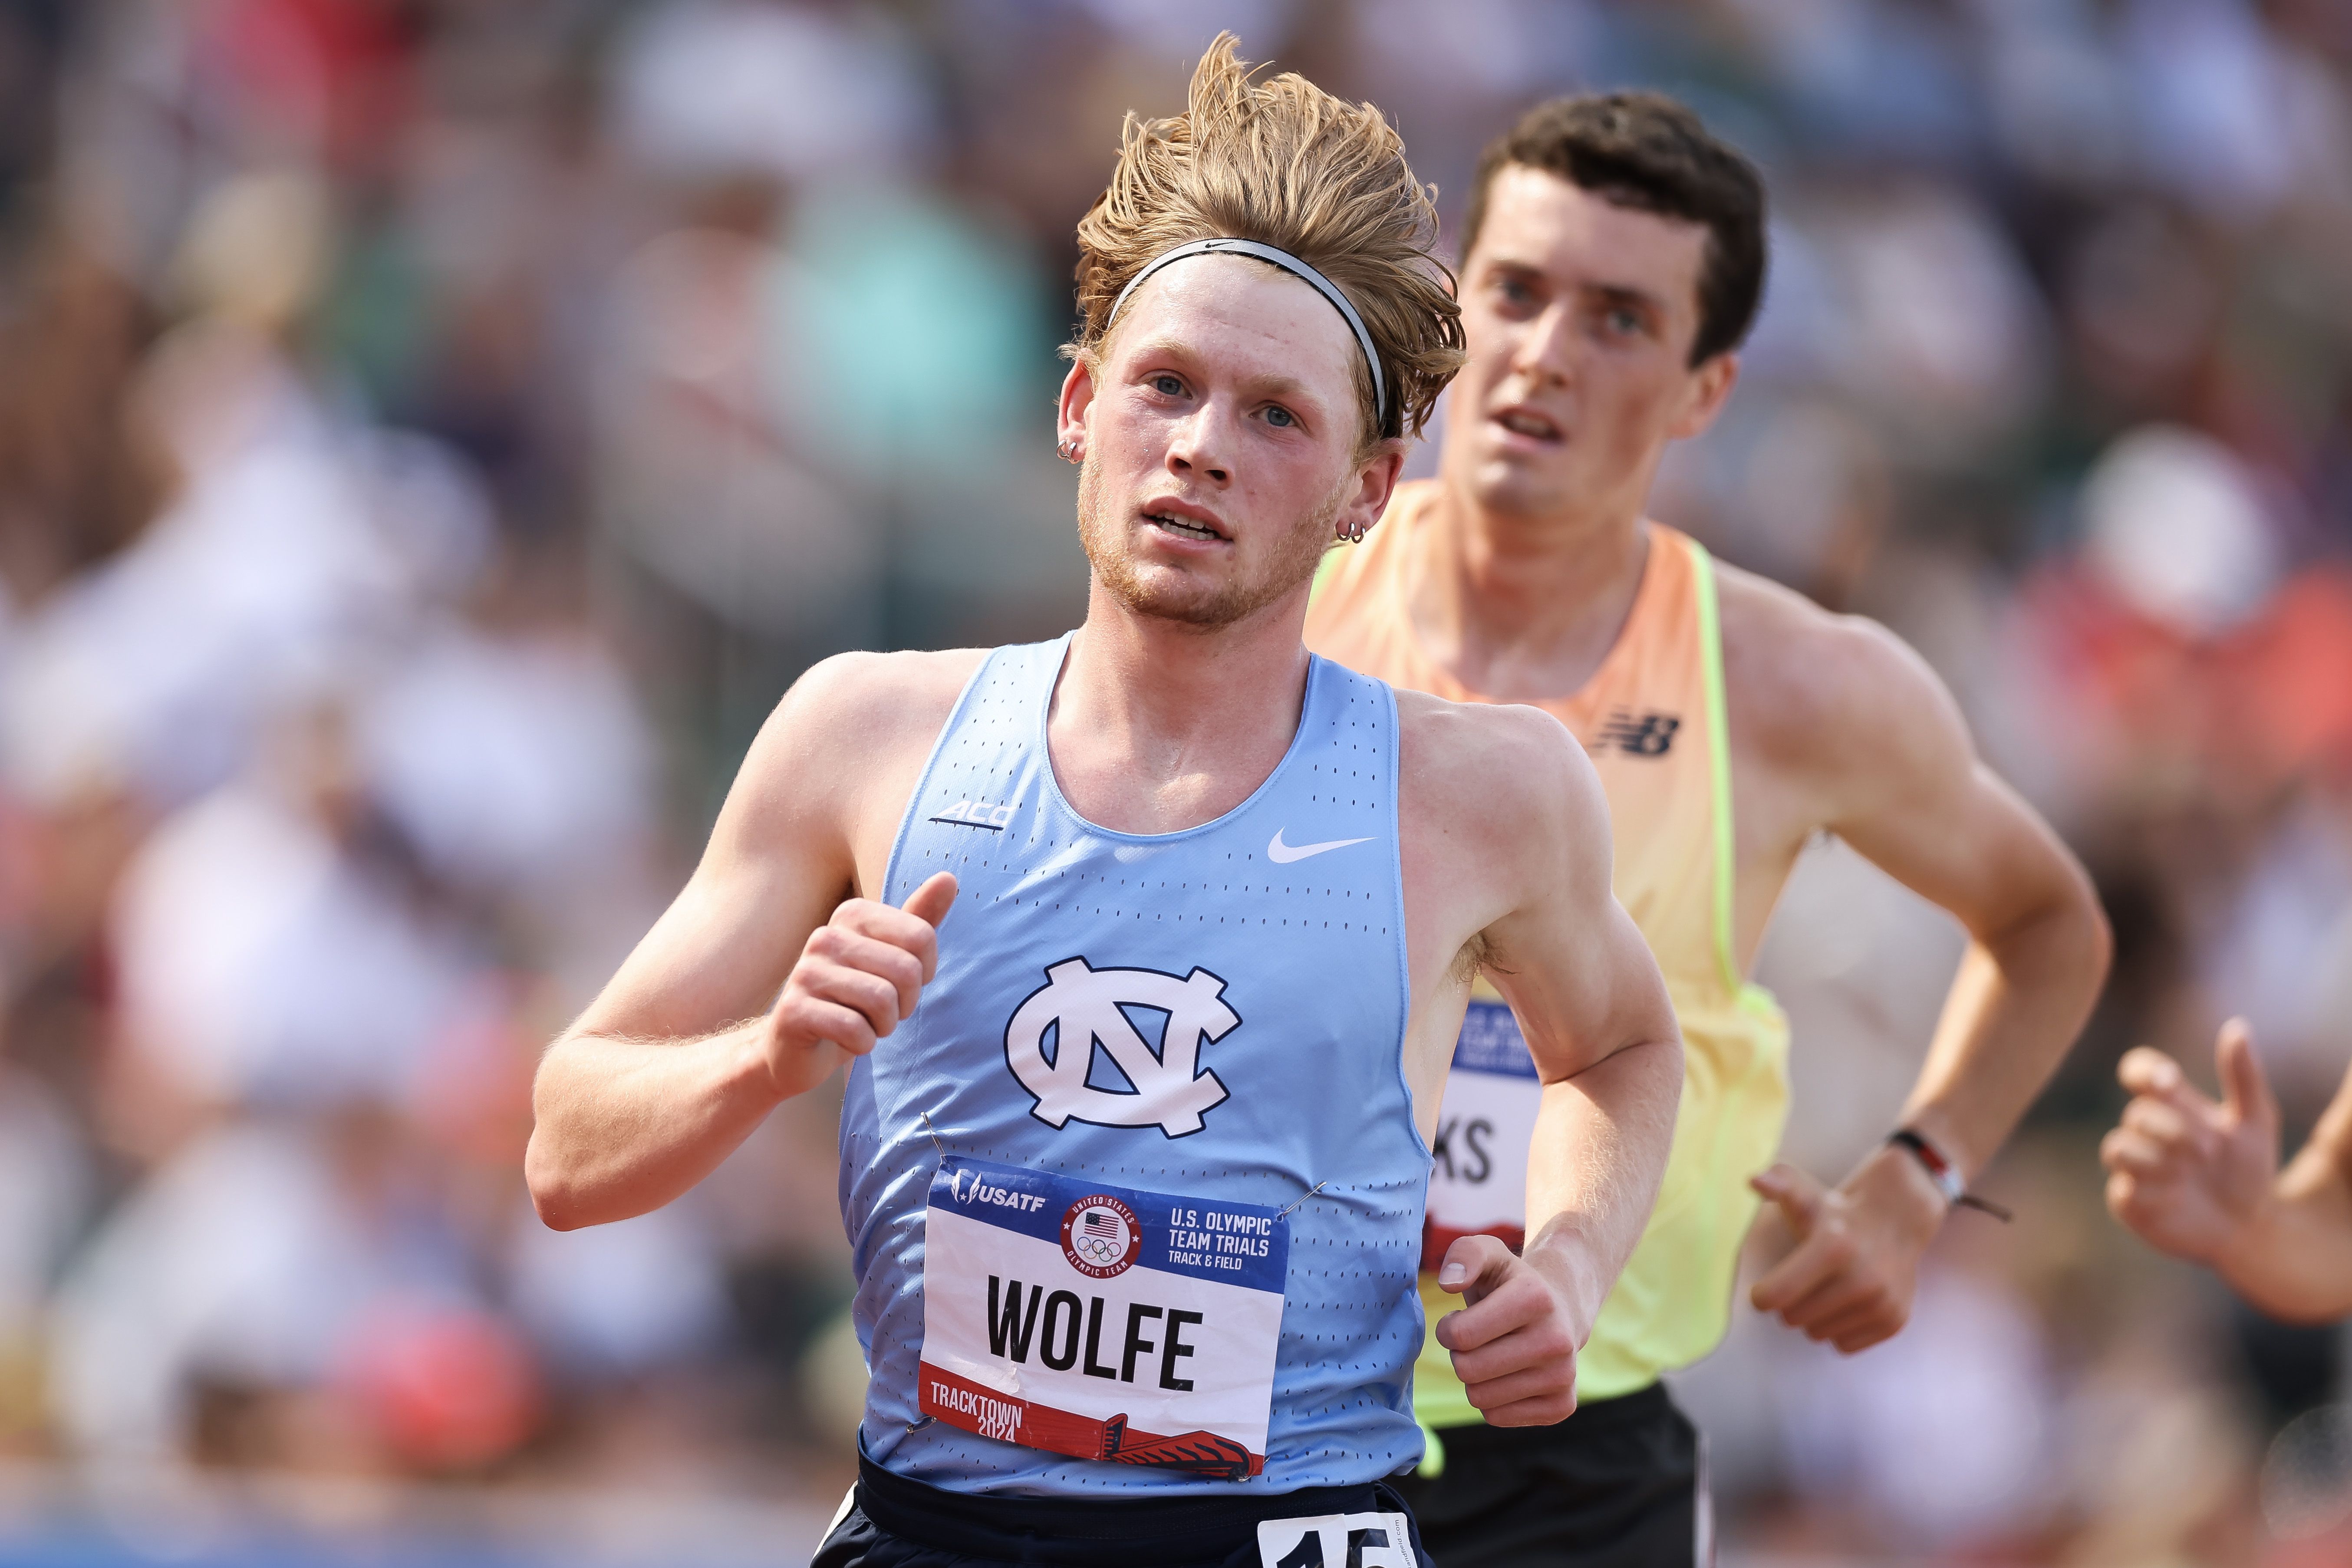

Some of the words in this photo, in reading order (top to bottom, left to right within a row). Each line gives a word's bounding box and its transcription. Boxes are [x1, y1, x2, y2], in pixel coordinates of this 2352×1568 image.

[978, 1185, 1046, 1212] USATF
[1072, 1196, 1103, 1213] UNITED
[1107, 1199, 1134, 1223] STATES
[1171, 1208, 1200, 1228] U.S.
[1206, 1212, 1272, 1236] OLYMPIC
[1169, 1229, 1211, 1251] TEAM
[1216, 1234, 1269, 1257] TRIALS
[1067, 1250, 1100, 1276] OLYMPIC
[1105, 1260, 1128, 1276] TEAM
[1169, 1250, 1202, 1266] TRACK
[1204, 1255, 1212, 1267] &
[1215, 1255, 1242, 1270] FIELD
[987, 1275, 1203, 1392] WOLFE
[931, 1381, 1022, 1429] TRACKTOWN
[978, 1416, 1015, 1443] 2024
